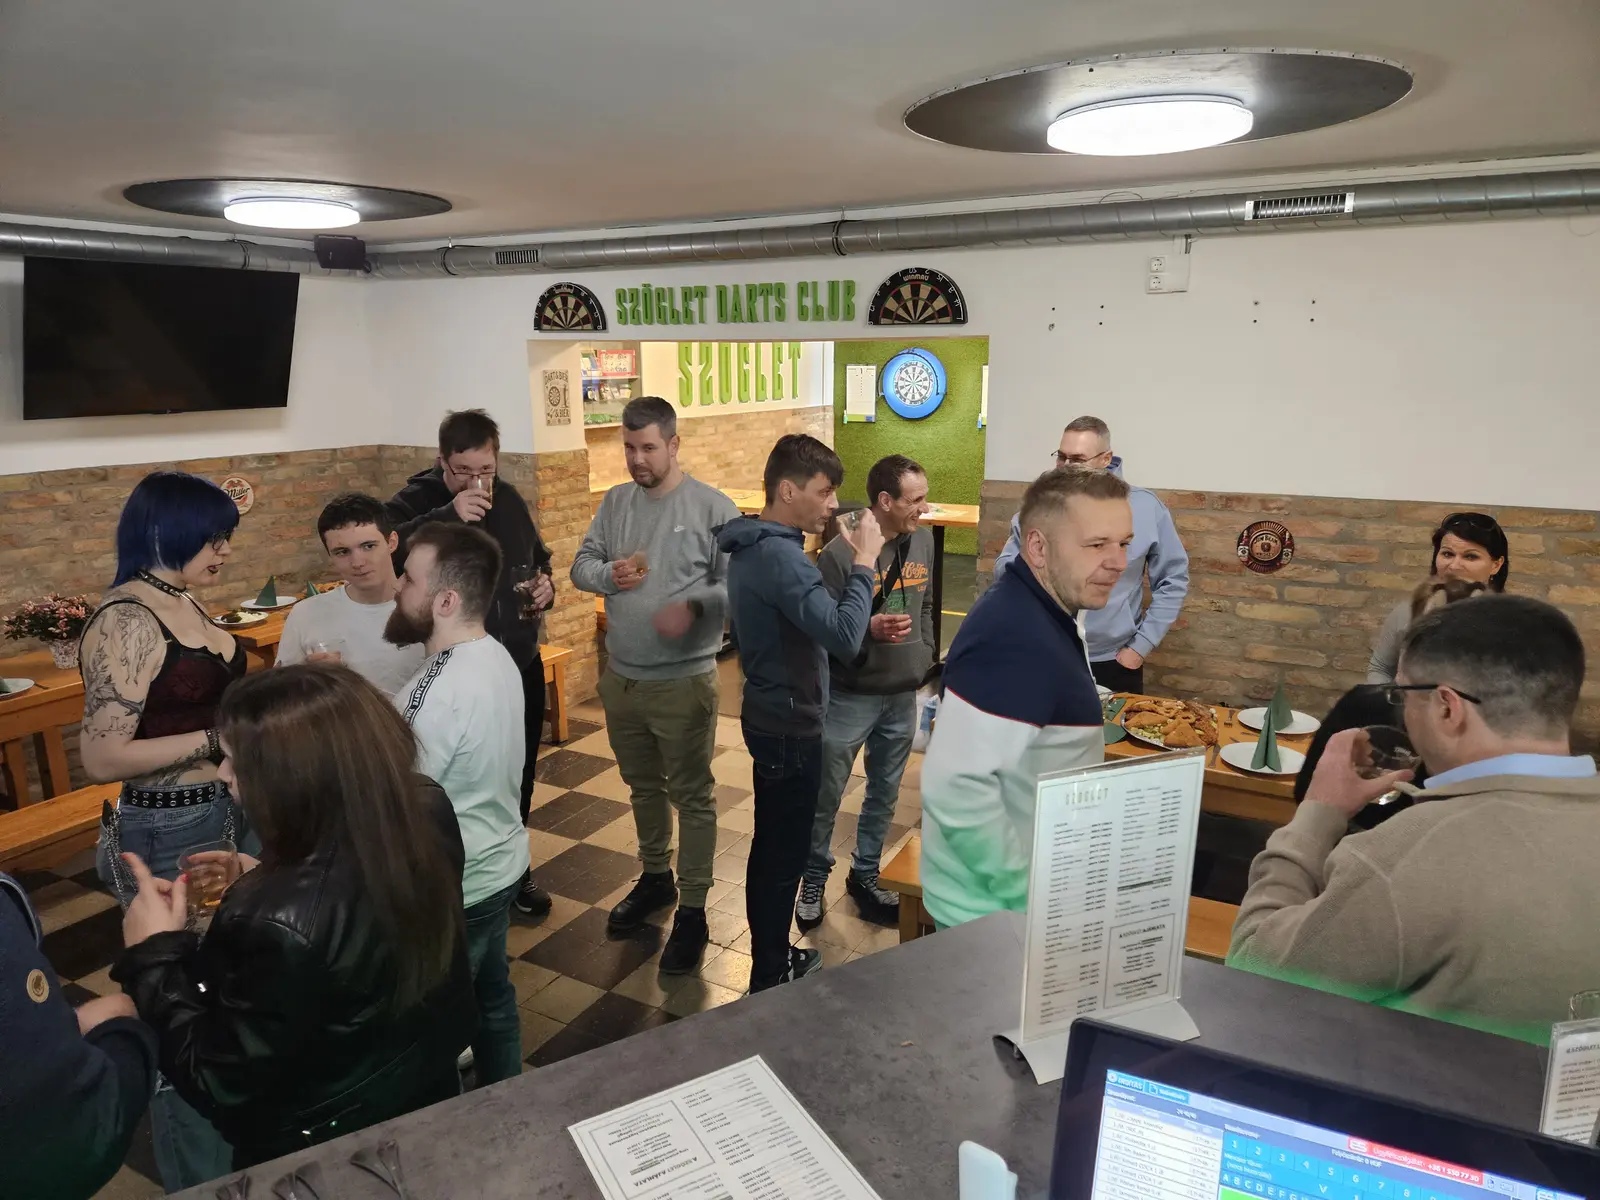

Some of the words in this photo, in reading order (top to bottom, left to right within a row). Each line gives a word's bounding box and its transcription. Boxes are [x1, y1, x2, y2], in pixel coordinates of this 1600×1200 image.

[615, 283, 707, 325] SZÖGLET
[715, 282, 786, 324] DARTS
[797, 279, 856, 322] CLUB
[223, 487, 250, 499] Miller
[1255, 1147, 1261, 1155] 2
[1279, 1153, 1285, 1162] 3
[1328, 1167, 1334, 1176] 5
[1233, 1177, 1240, 1185] B
[1352, 1174, 1359, 1183] 6
[1244, 1180, 1251, 1188] C
[1256, 1183, 1262, 1192] D
[1378, 1182, 1385, 1190] 7
[1268, 1187, 1274, 1196] E
[1403, 1189, 1410, 1197] 8
